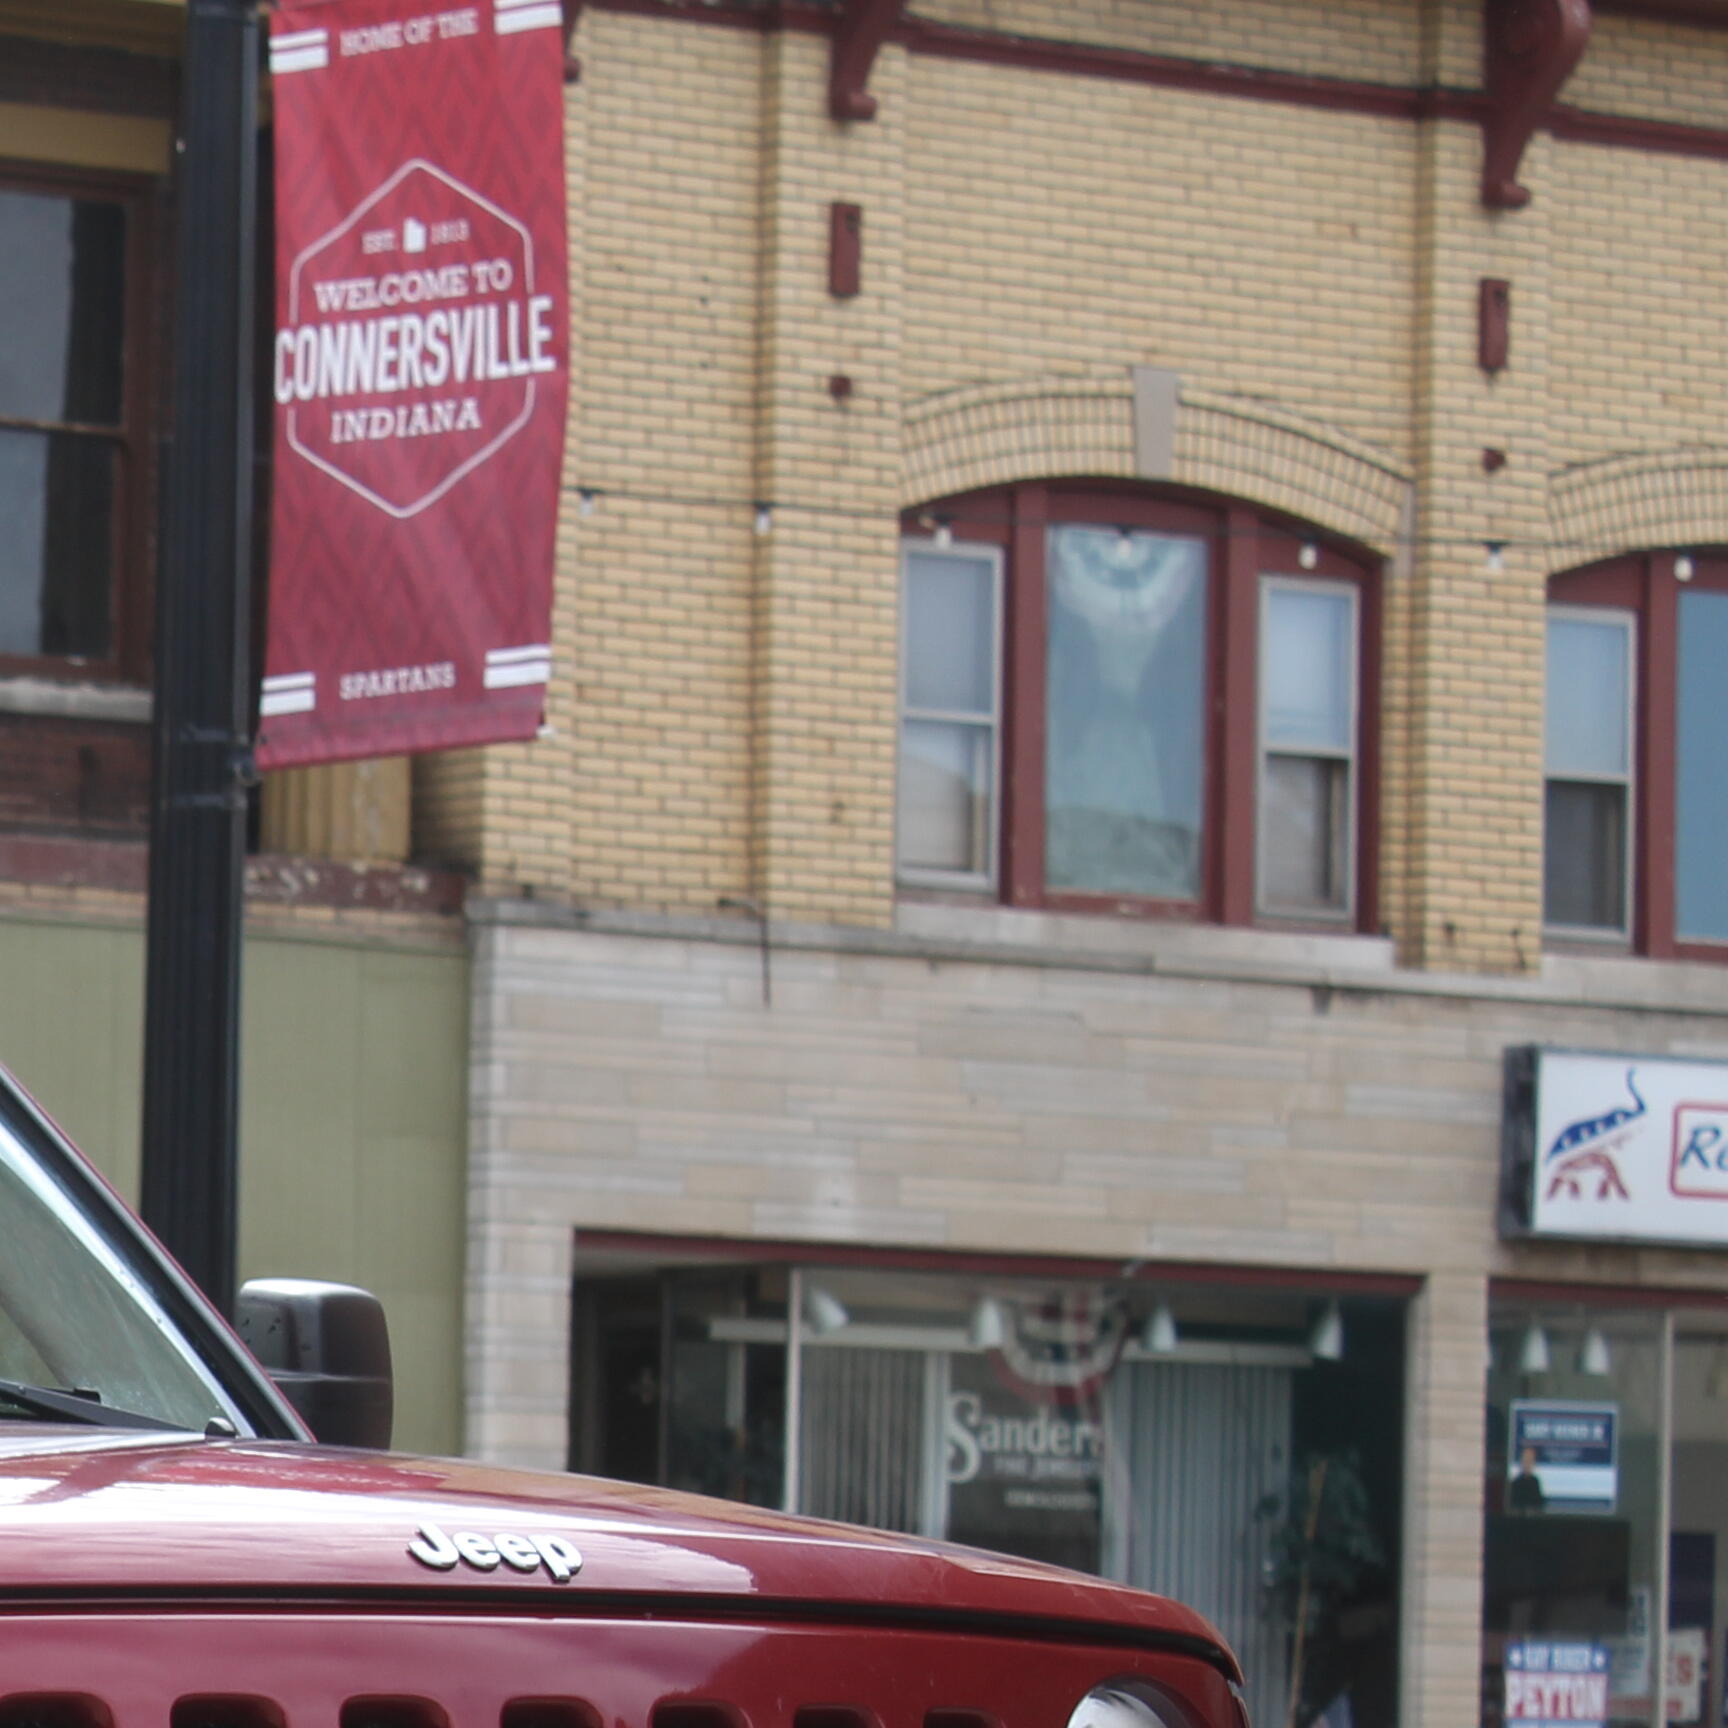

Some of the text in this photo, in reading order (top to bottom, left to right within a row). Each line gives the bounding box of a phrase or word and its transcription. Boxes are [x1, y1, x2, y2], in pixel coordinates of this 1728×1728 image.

[340, 7, 479, 56] HOME OF THE
[314, 258, 513, 312] WELCOME TO
[274, 295, 557, 404] CONNERSVILLE
[330, 398, 482, 444] INDIANA
[339, 661, 455, 700] SPARTANS
[406, 1520, 583, 1584] Jeep
